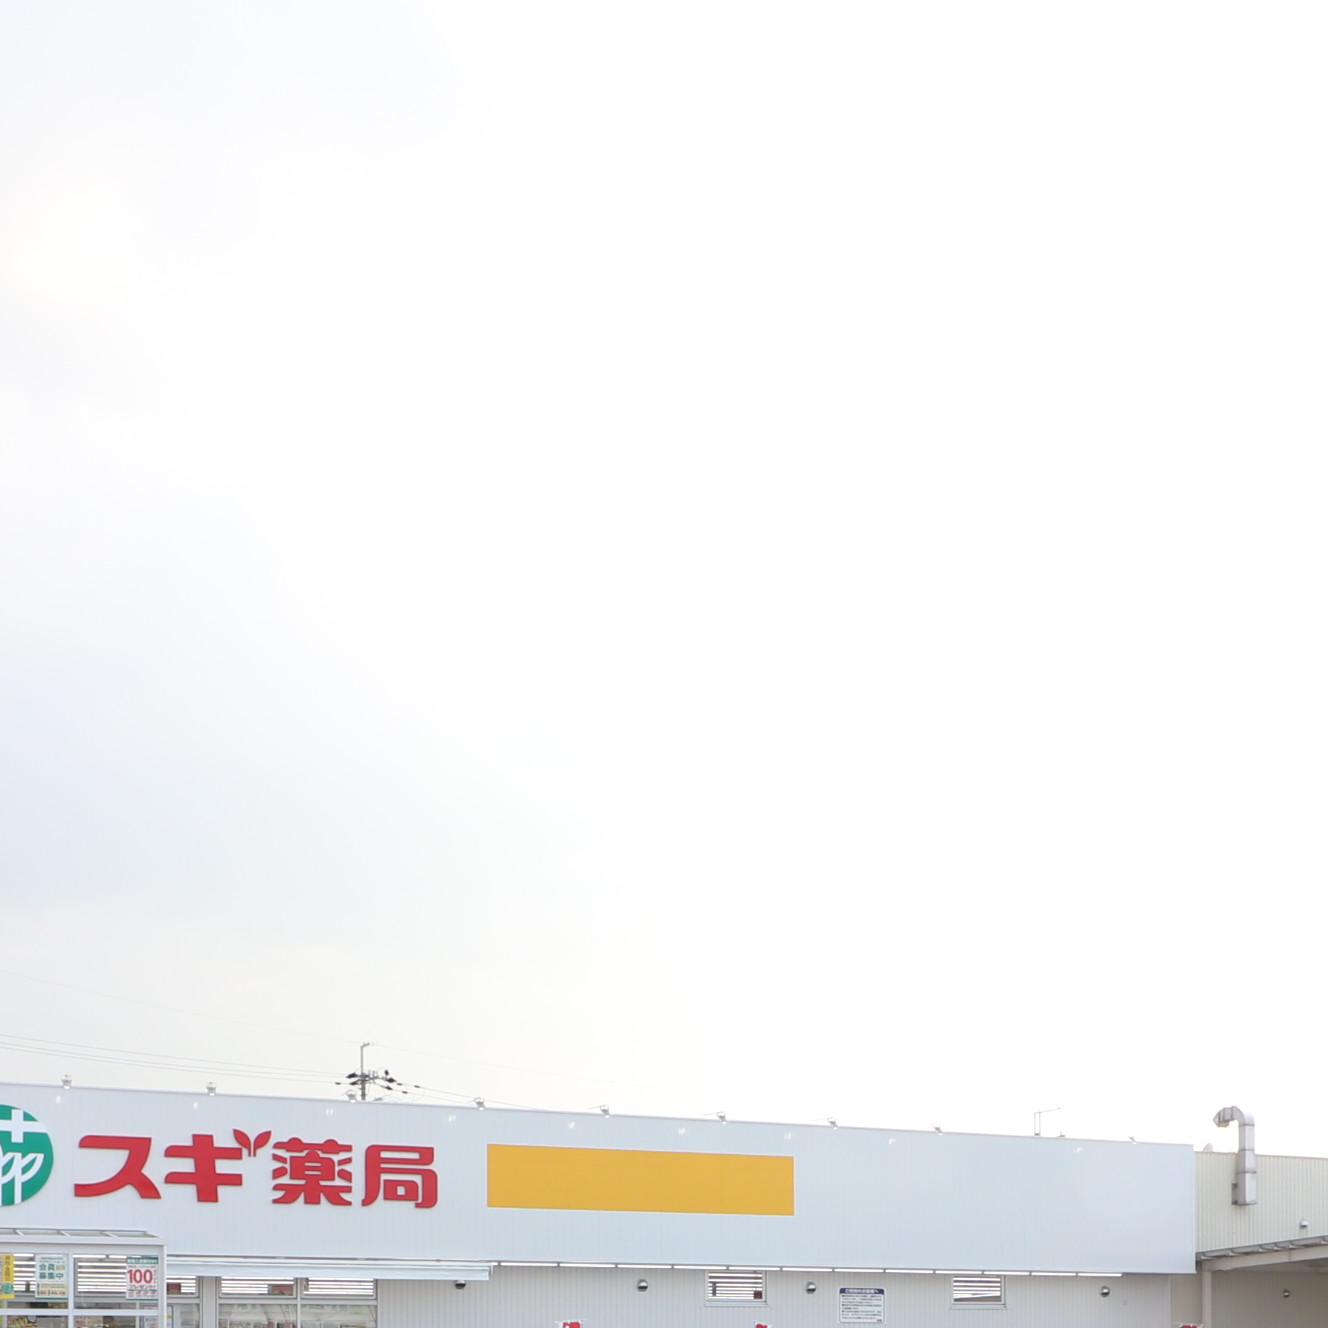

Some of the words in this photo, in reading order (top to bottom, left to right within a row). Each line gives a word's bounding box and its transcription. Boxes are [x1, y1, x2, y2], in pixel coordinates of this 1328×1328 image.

[74, 1129, 438, 1208] スギ薬局
[127, 1269, 153, 1284] 100
